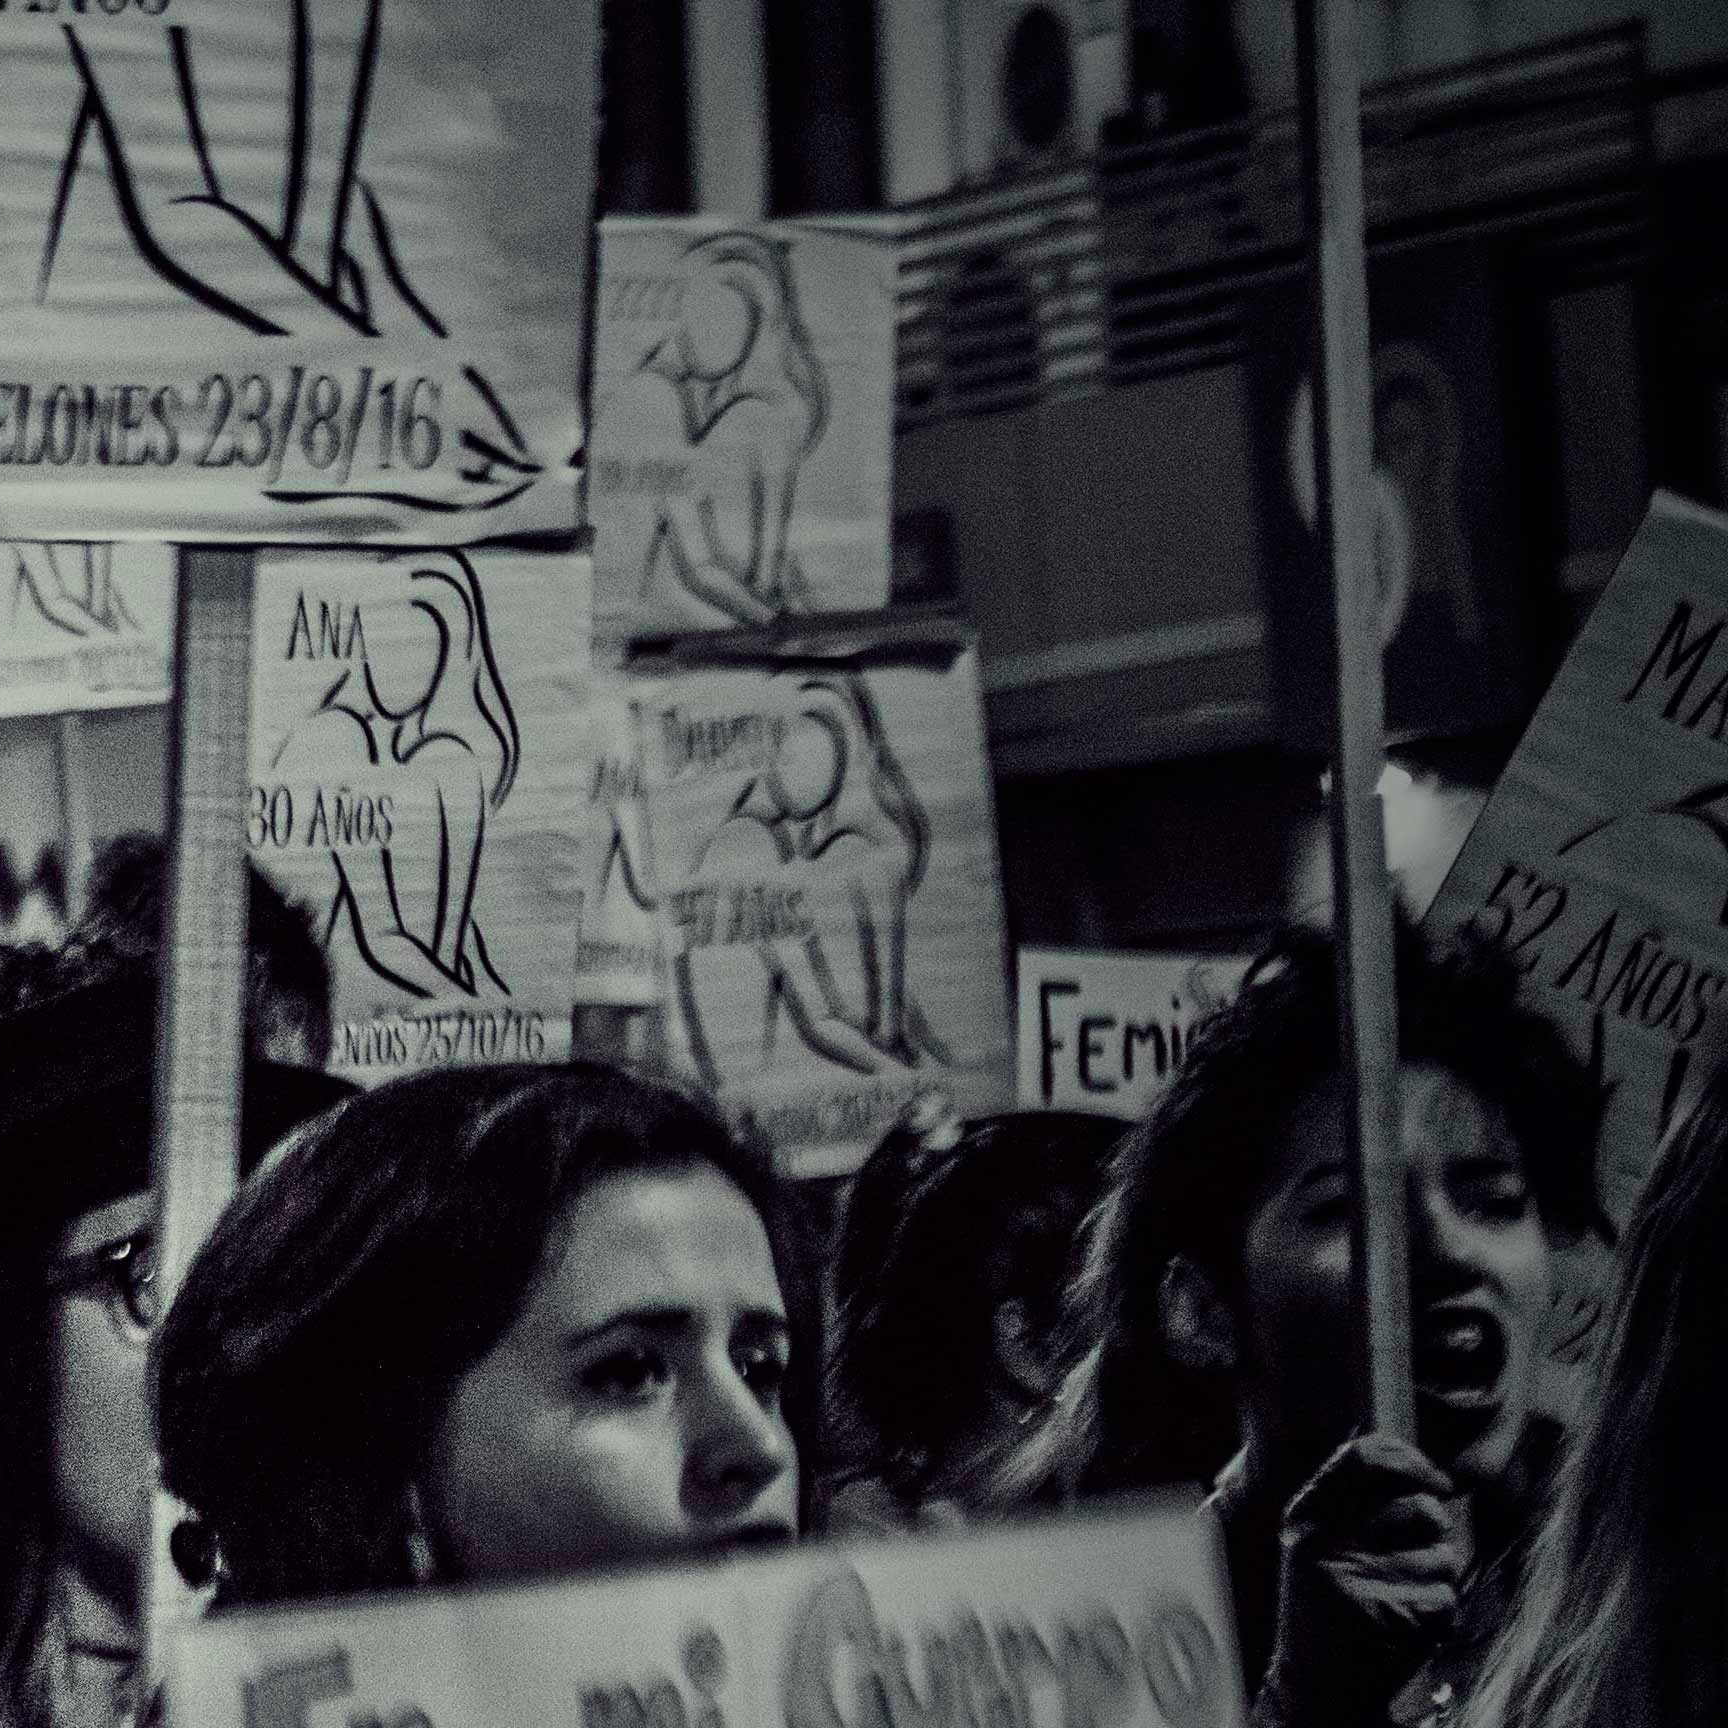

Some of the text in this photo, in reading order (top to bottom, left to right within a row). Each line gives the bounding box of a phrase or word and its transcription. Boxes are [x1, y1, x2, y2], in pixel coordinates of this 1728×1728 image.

[196, 366, 443, 485] 23/8/16
[286, 591, 368, 661] ANA
[246, 785, 395, 849] 30 AÑOS
[1553, 908, 1726, 1043] AÑOS
